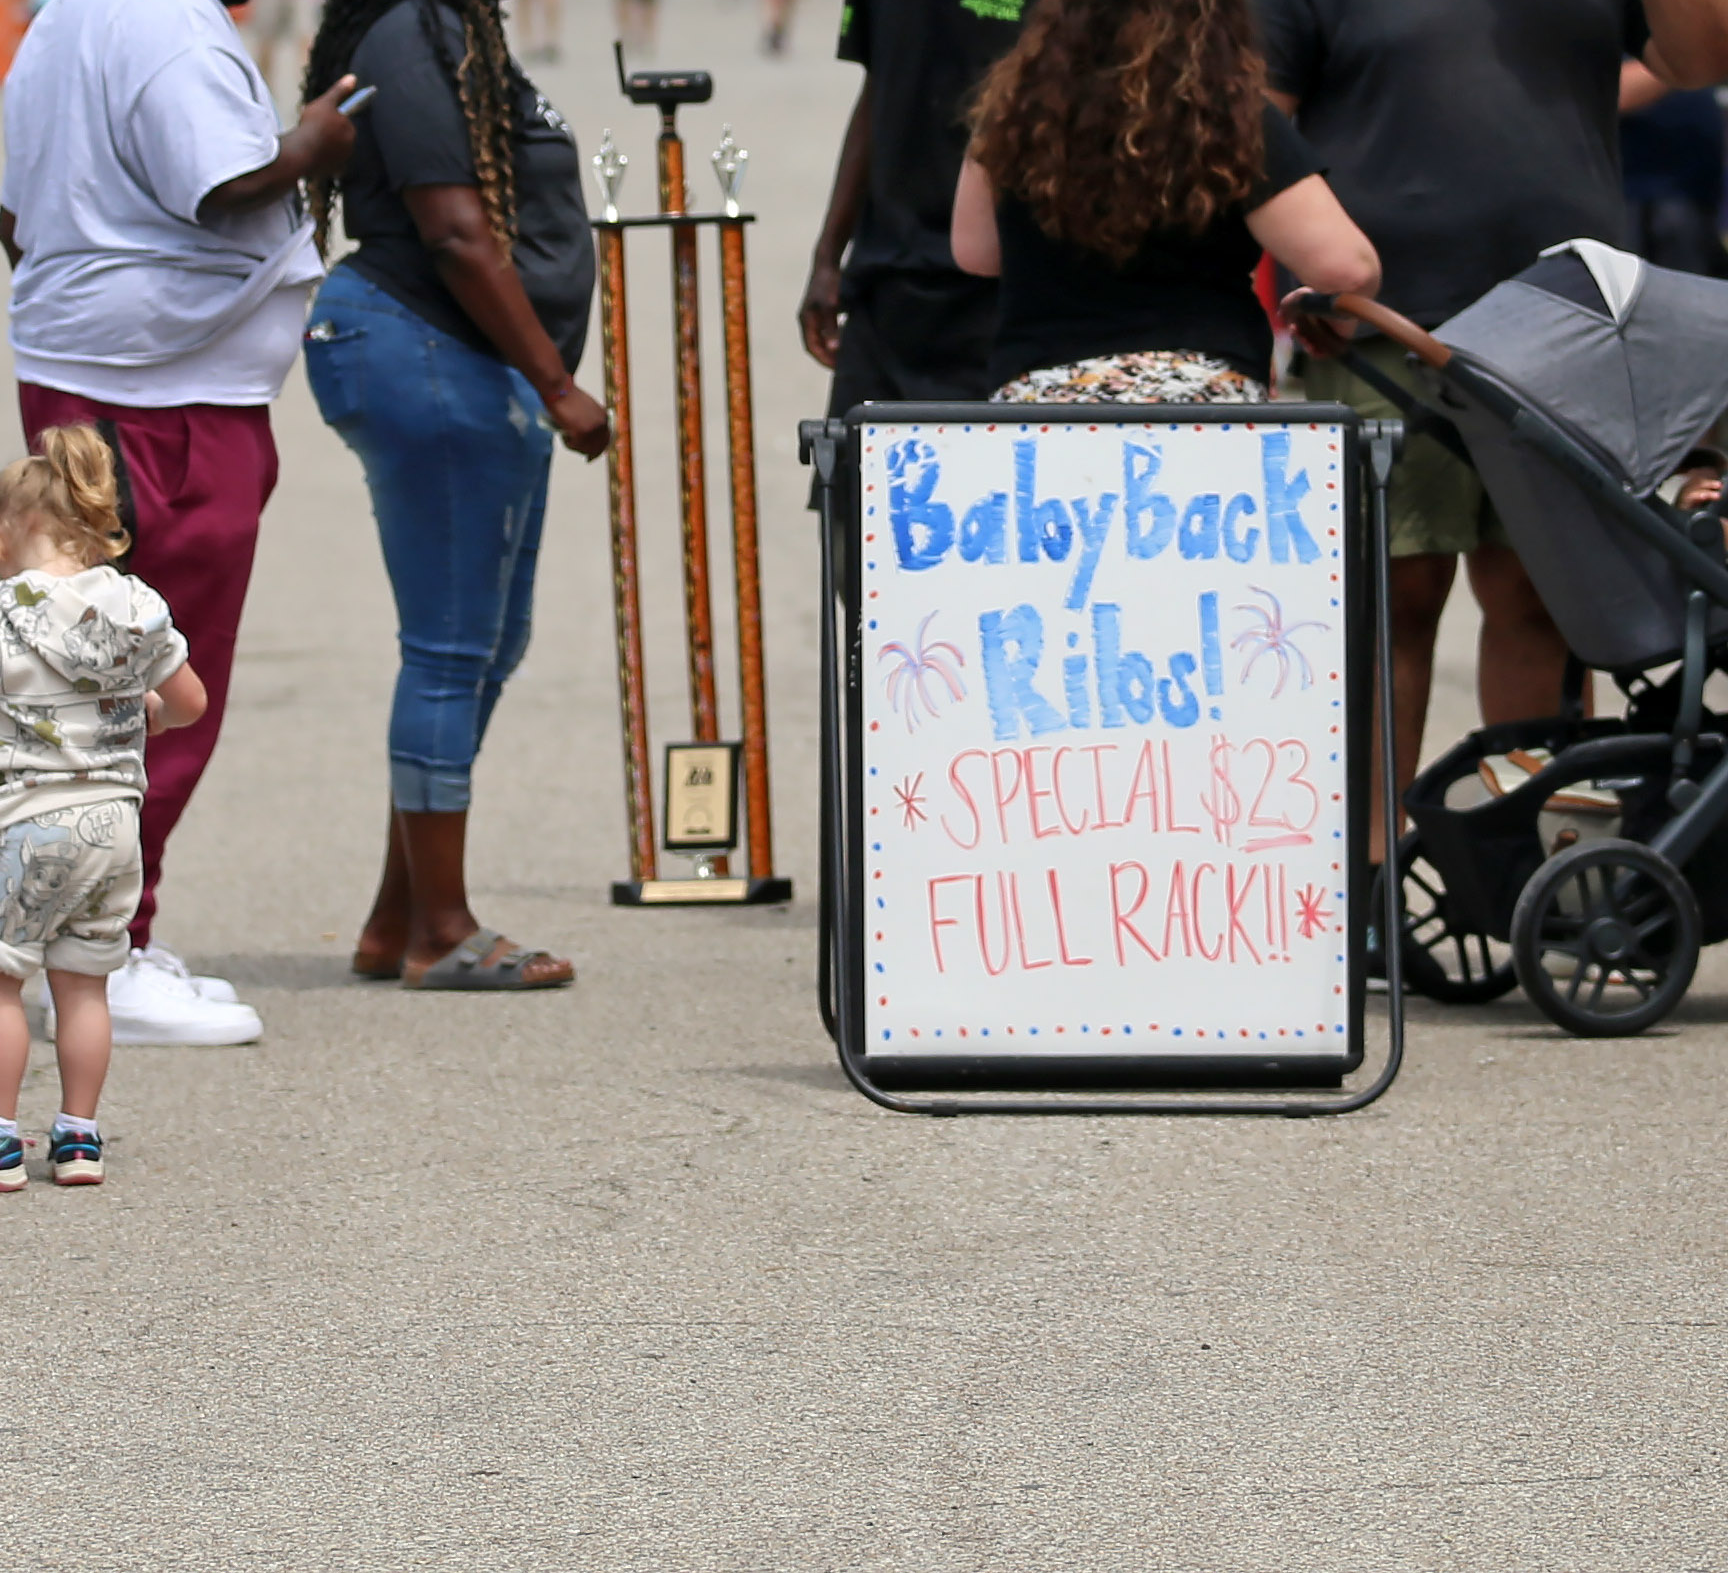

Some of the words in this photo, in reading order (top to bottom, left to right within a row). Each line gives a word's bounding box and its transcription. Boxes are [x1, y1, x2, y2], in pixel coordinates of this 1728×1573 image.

[978, 590, 1224, 740] Ribs!
[941, 738, 1200, 850] SPECIAL
[1200, 734, 1320, 847] $23
[928, 865, 1093, 975] FULL
[1110, 860, 1292, 967] RACK!!
